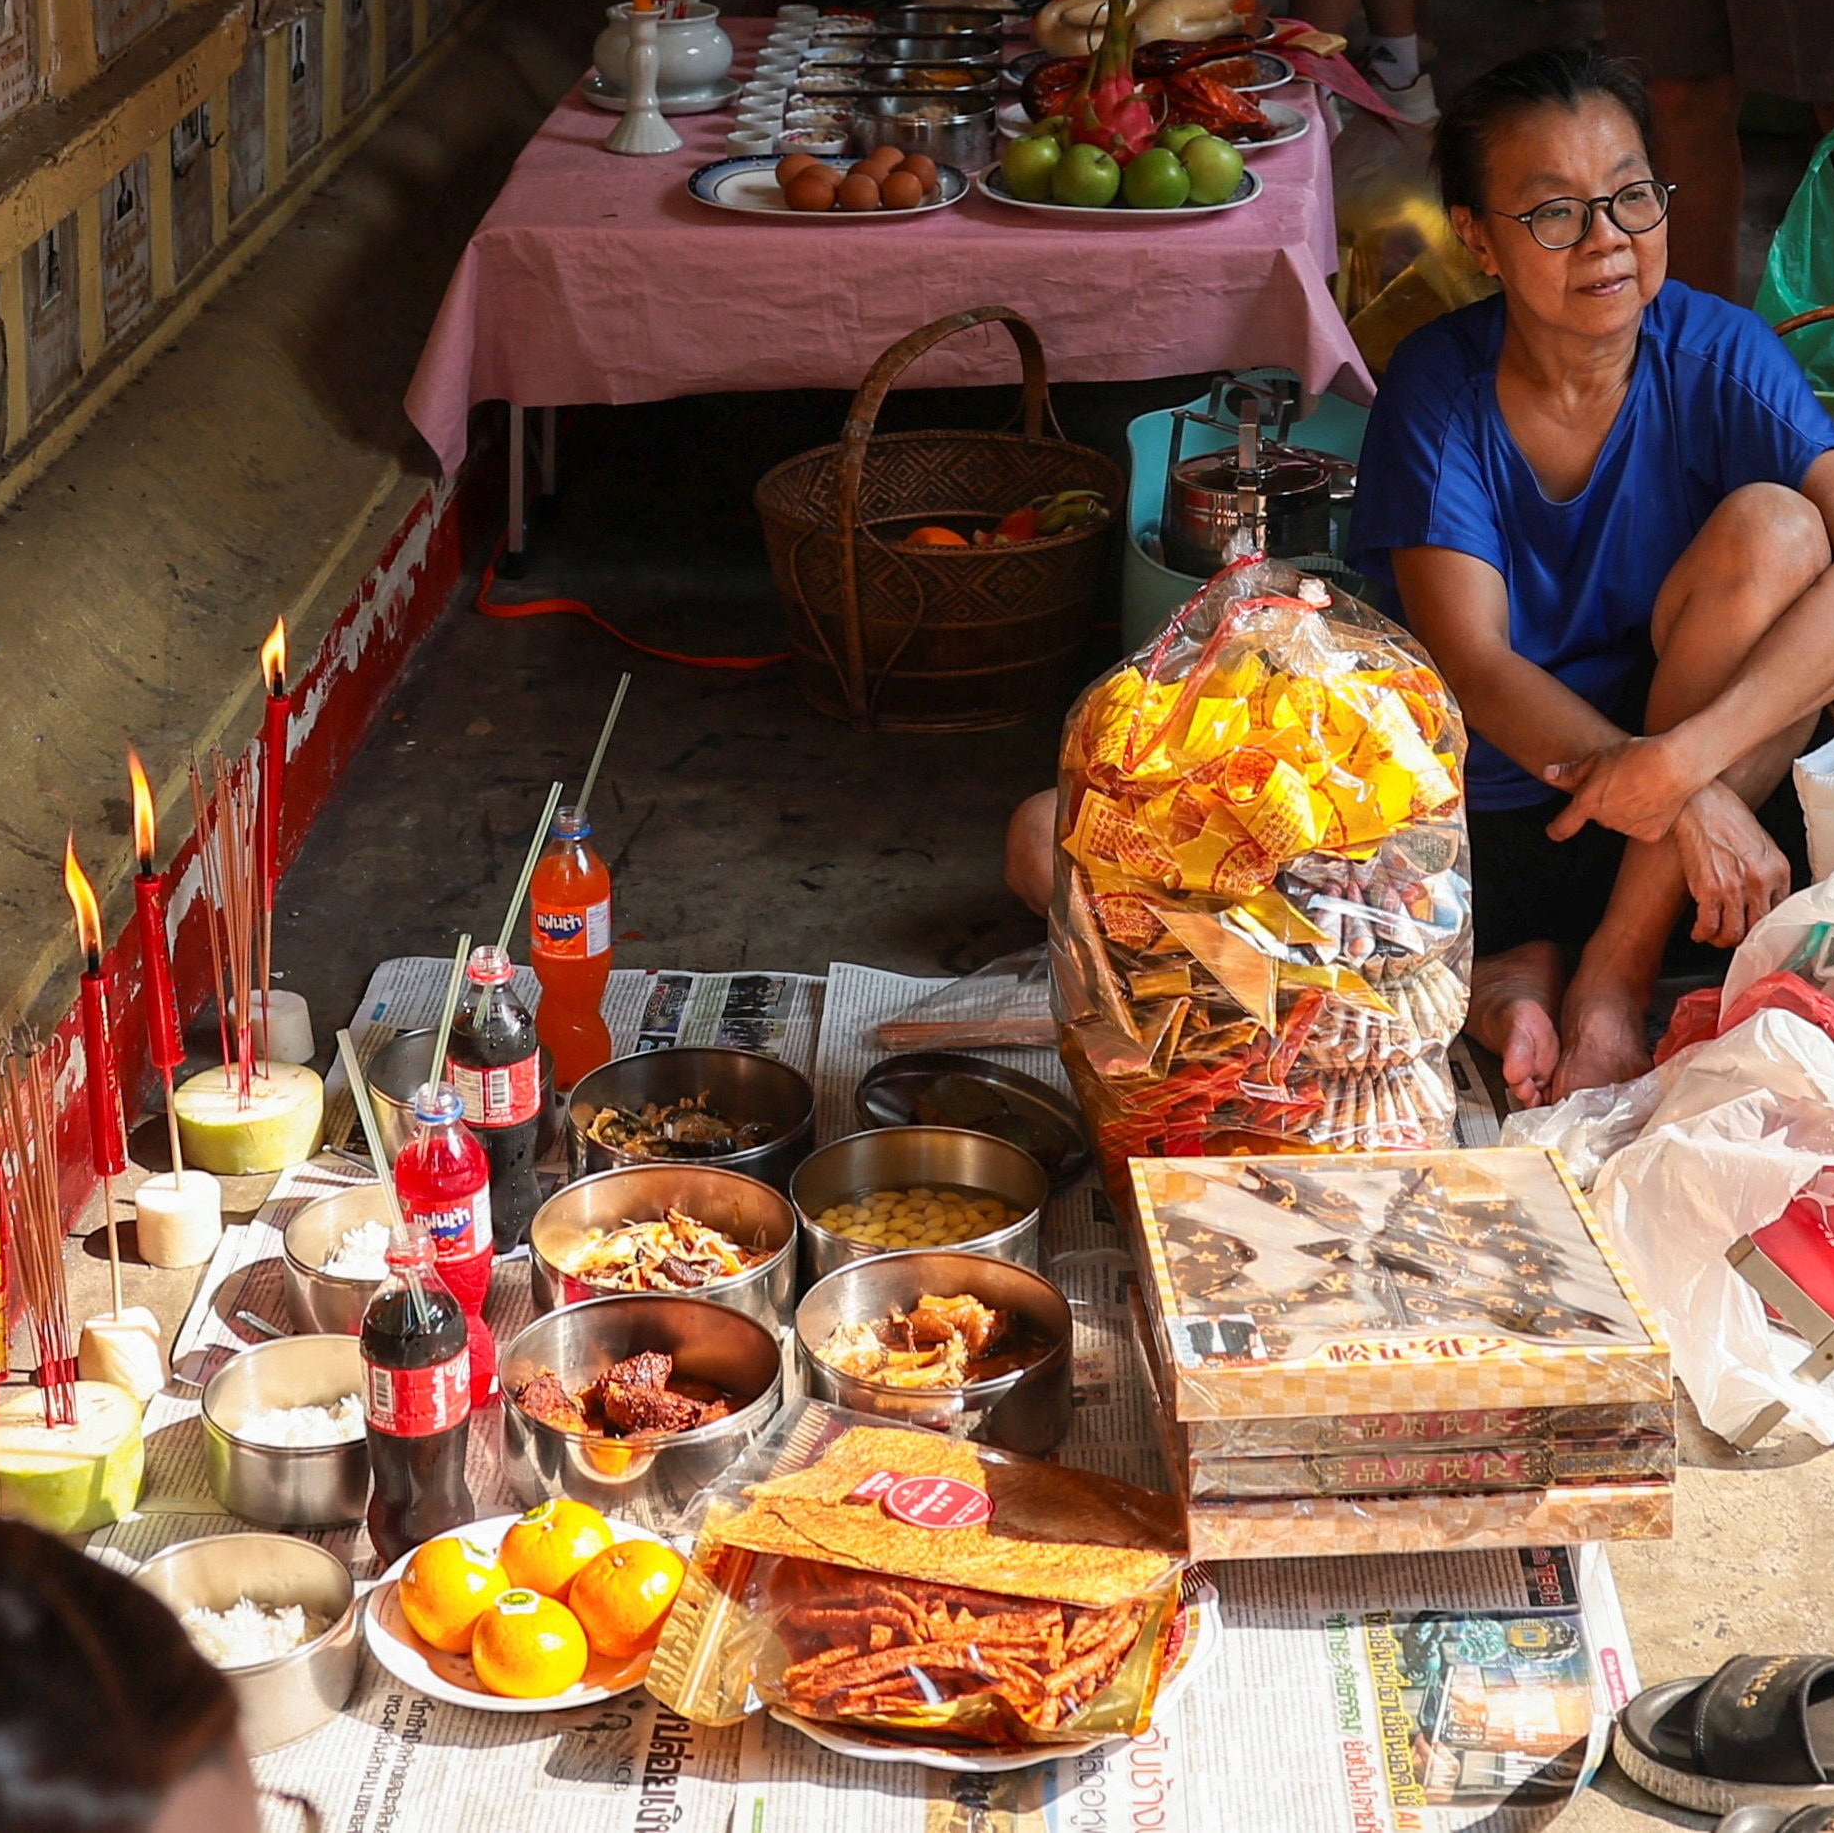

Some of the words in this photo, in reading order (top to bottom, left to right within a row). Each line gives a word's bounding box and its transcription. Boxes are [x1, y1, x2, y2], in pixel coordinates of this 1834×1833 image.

[536, 910, 583, 935] แฟนต้า
[412, 1204, 471, 1231] แฟนต้า
[1360, 1414, 1513, 1439] 品质优良
[1355, 1459, 1513, 1484] 品质优良
[1533, 1564, 1562, 1605] TECH
